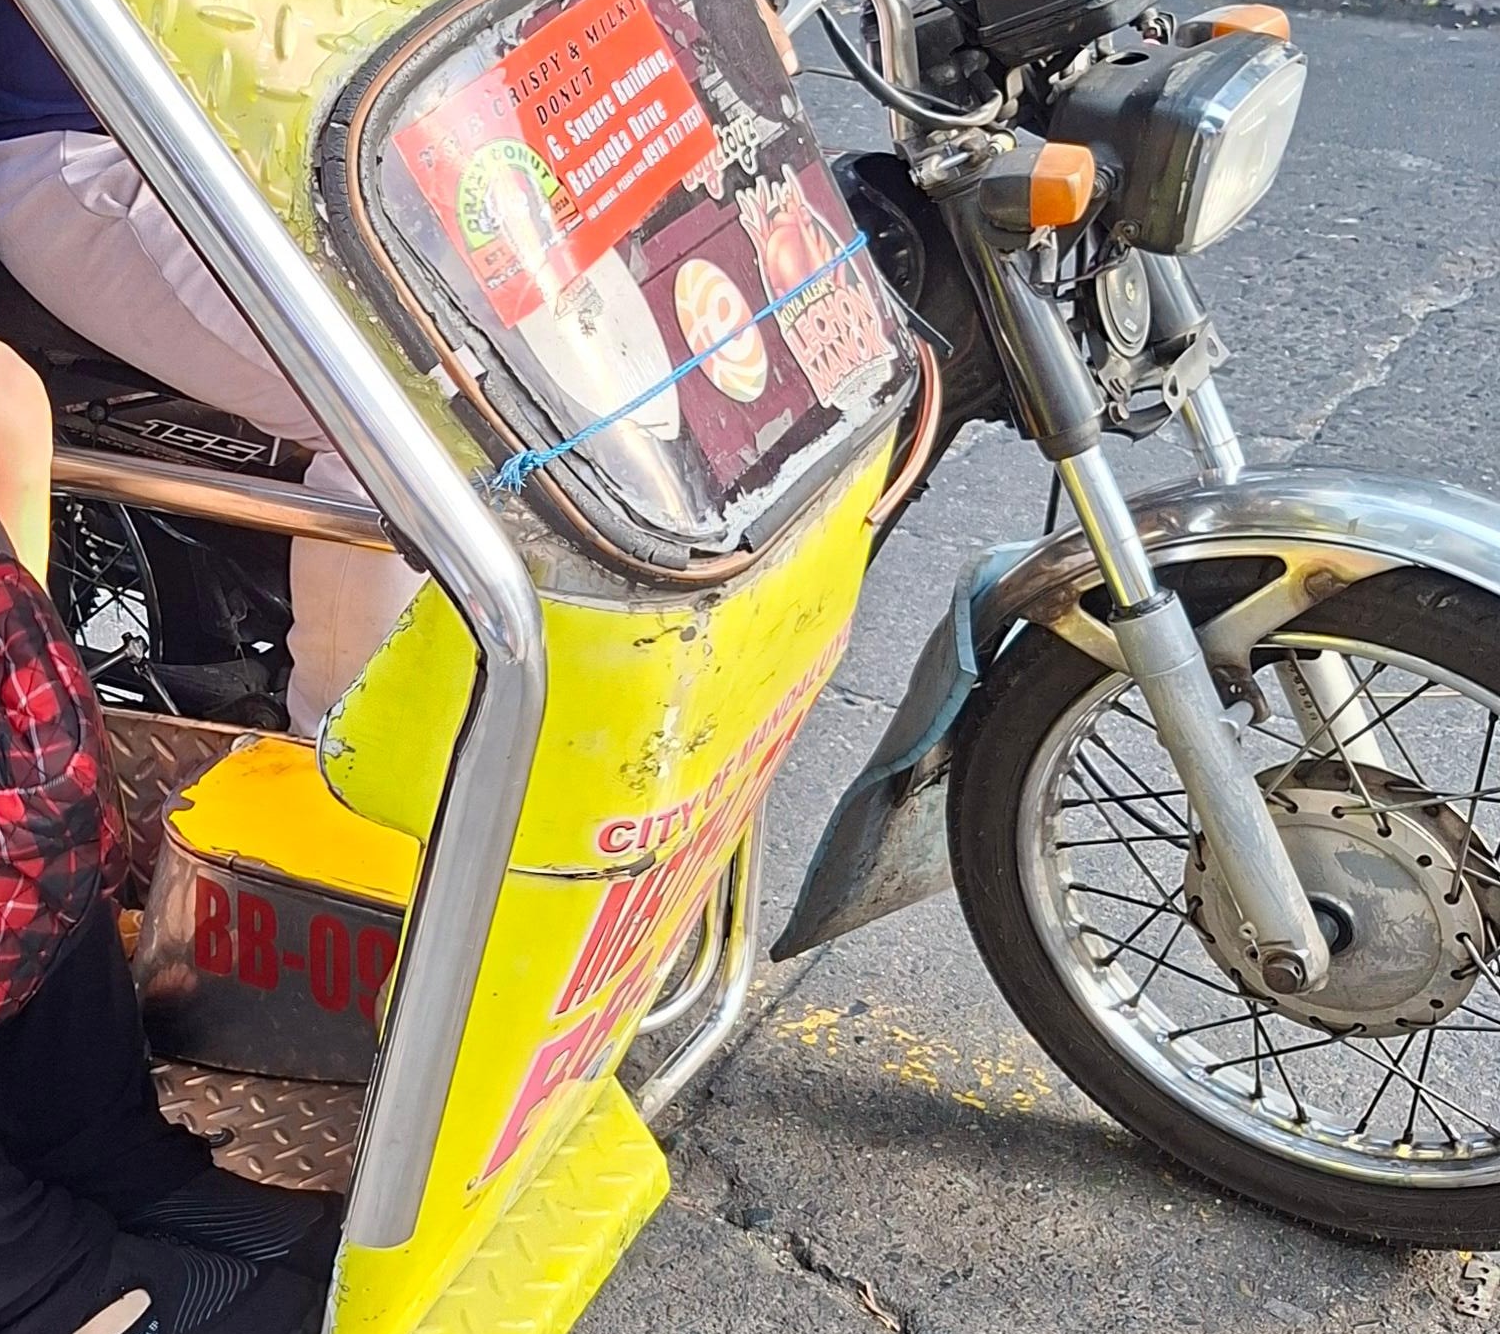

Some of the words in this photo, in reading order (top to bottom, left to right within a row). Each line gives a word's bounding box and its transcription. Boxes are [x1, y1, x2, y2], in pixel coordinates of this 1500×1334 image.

[491, 51, 564, 119] CRISPY
[568, 42, 581, 61] &
[535, 65, 597, 126] DONUT
[564, 94, 617, 148] Square
[564, 128, 634, 198] Barangka
[626, 99, 668, 142] Drive
[780, 296, 804, 330] KUYA
[786, 282, 876, 365] LECHON
[806, 320, 892, 402] MANOK
[598, 792, 700, 853] CITY
[704, 756, 736, 811] OF
